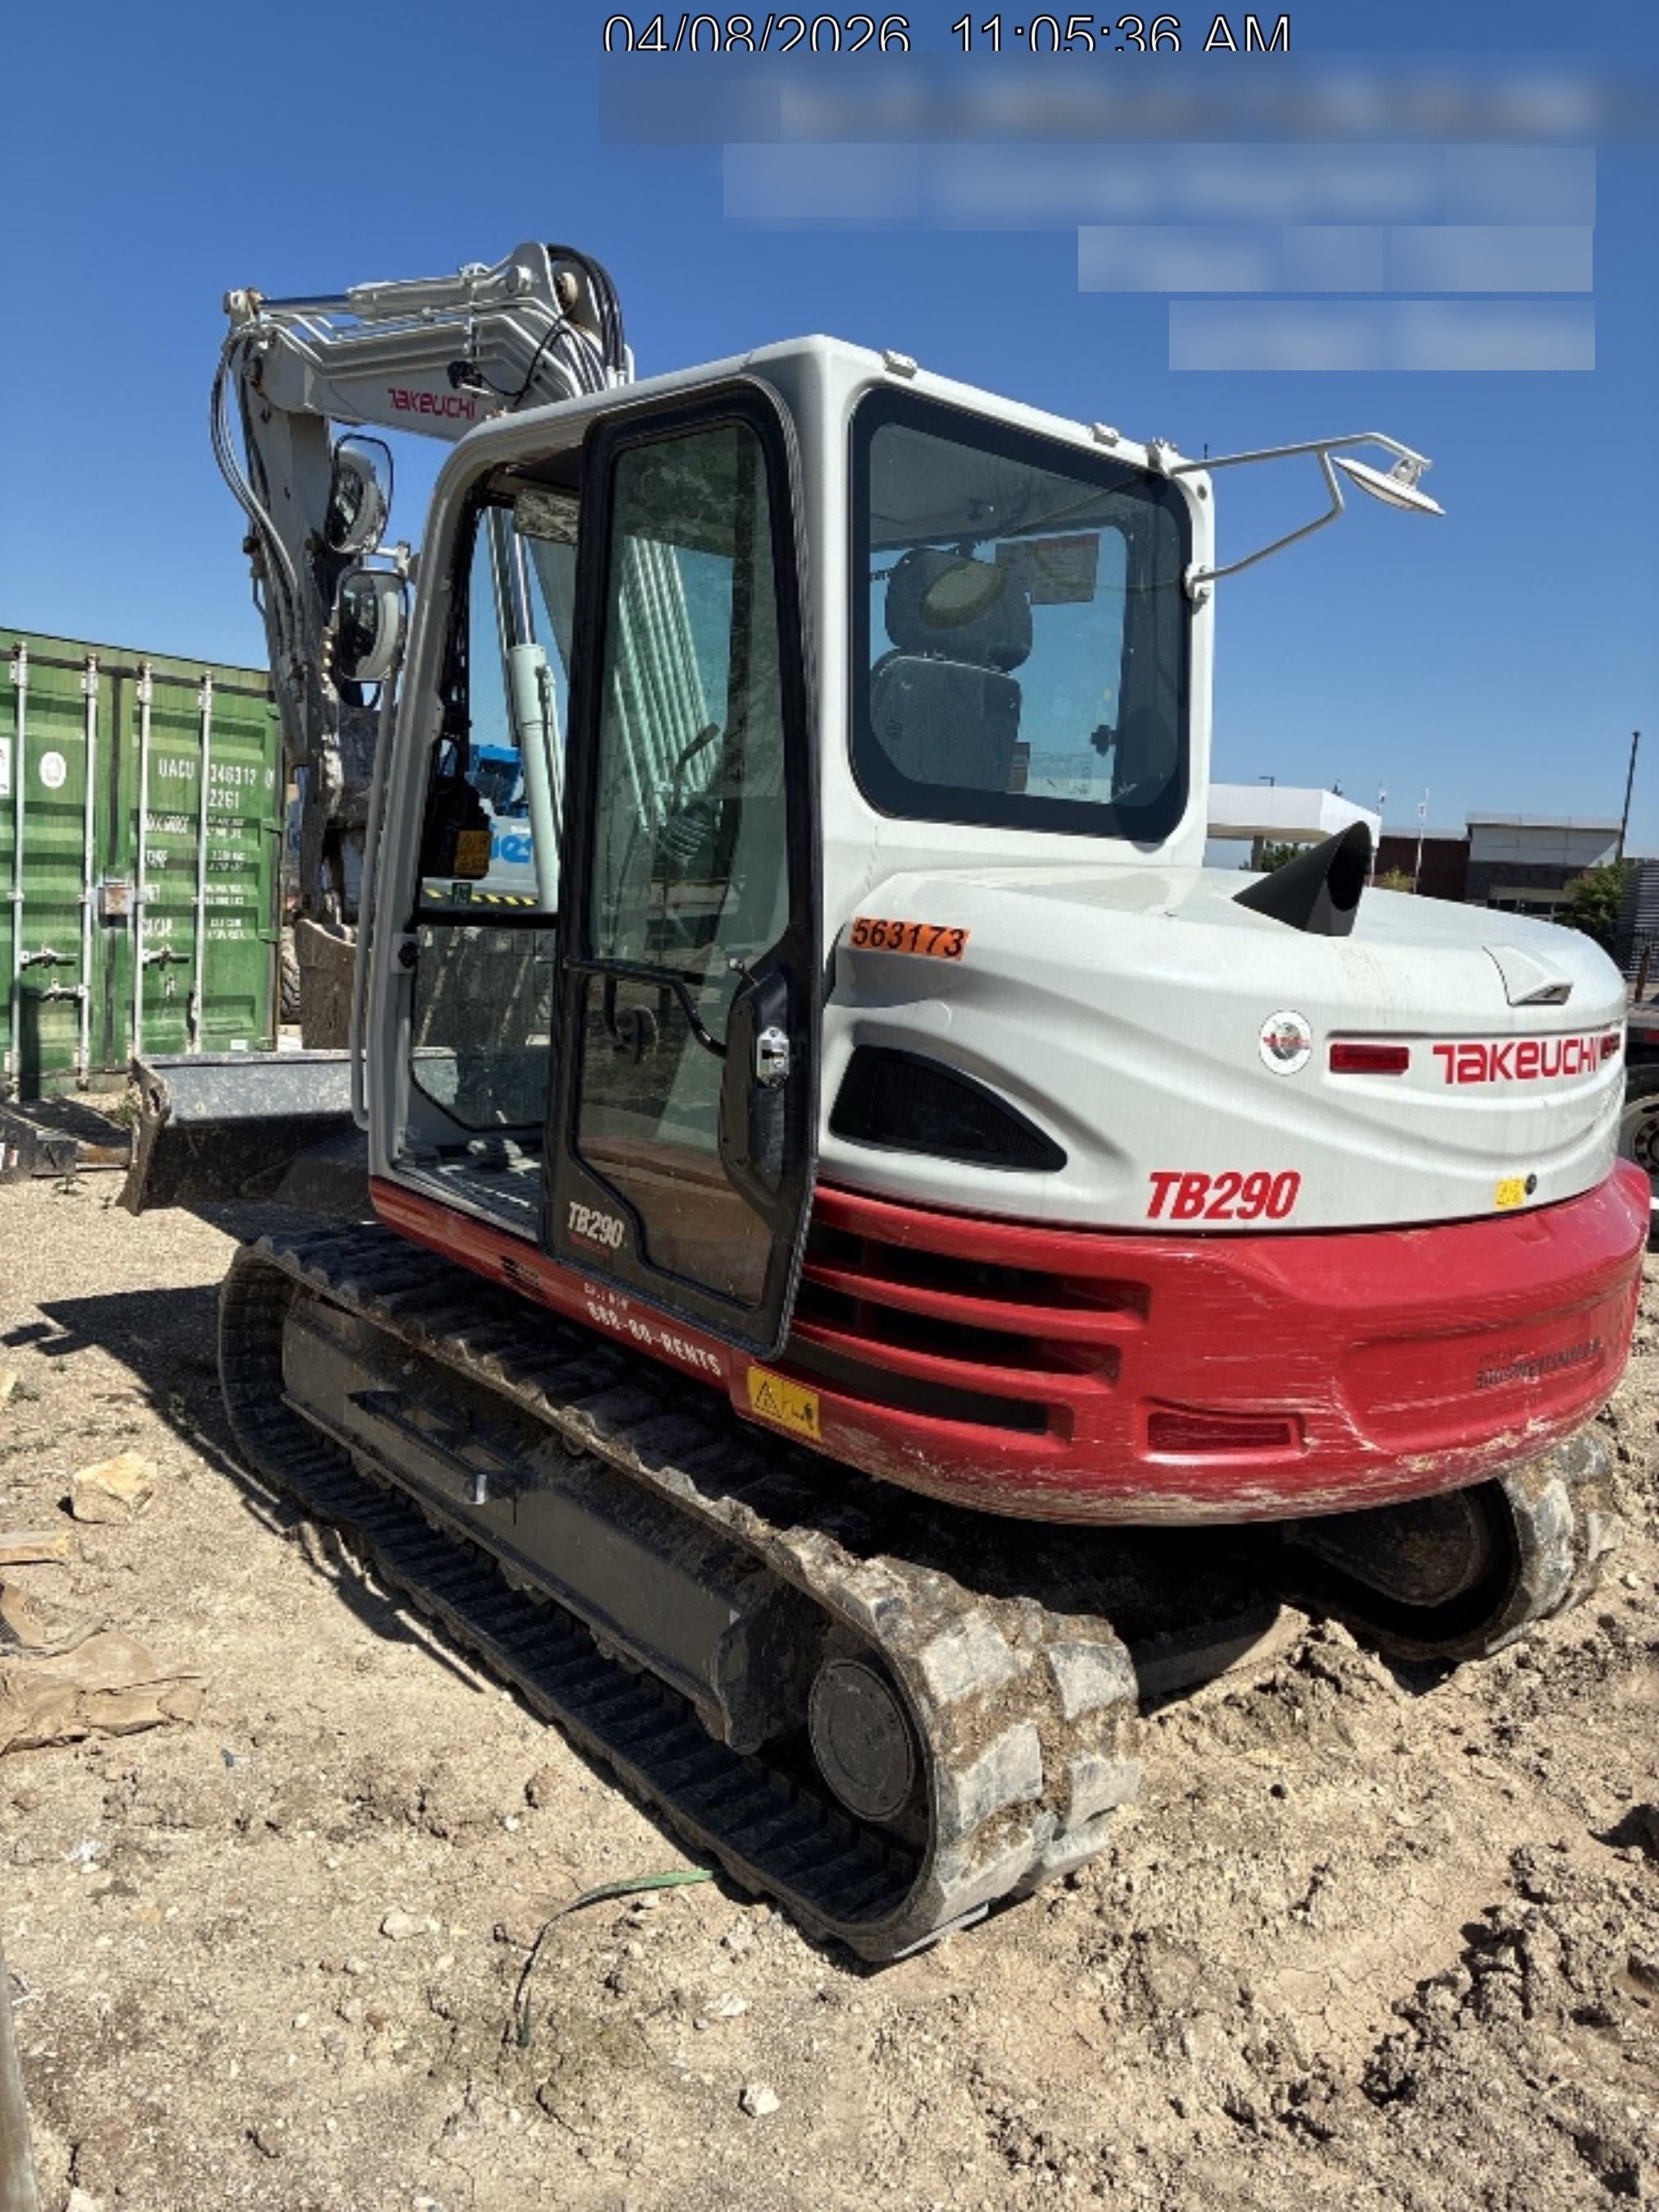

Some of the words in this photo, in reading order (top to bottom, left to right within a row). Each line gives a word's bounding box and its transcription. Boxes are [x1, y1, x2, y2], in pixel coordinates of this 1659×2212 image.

[850, 919, 966, 958] 563173
[1146, 1171, 1301, 1220] TB290
[567, 1201, 624, 1249] TB290
